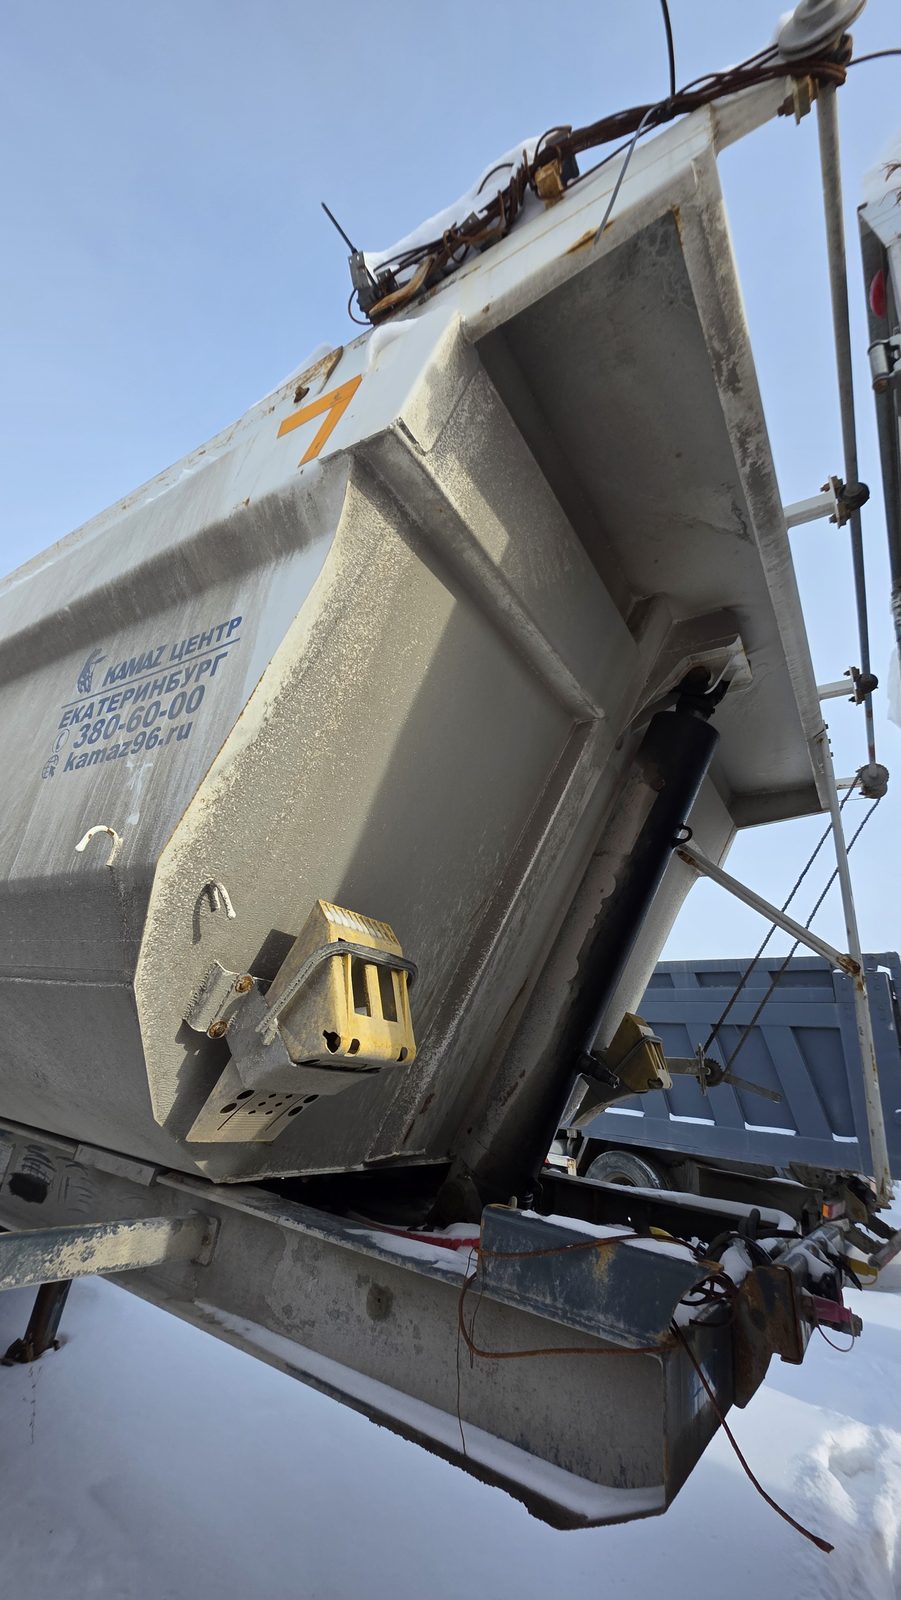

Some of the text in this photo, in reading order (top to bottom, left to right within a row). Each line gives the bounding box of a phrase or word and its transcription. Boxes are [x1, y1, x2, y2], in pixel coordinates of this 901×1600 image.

[102, 616, 242, 687] KAMAZ ЦЕНТР
[58, 652, 228, 729] ЕКАТЕРИНБУРГ
[73, 684, 206, 749] 380-60-00
[63, 721, 193, 772] kamaz96.ru
